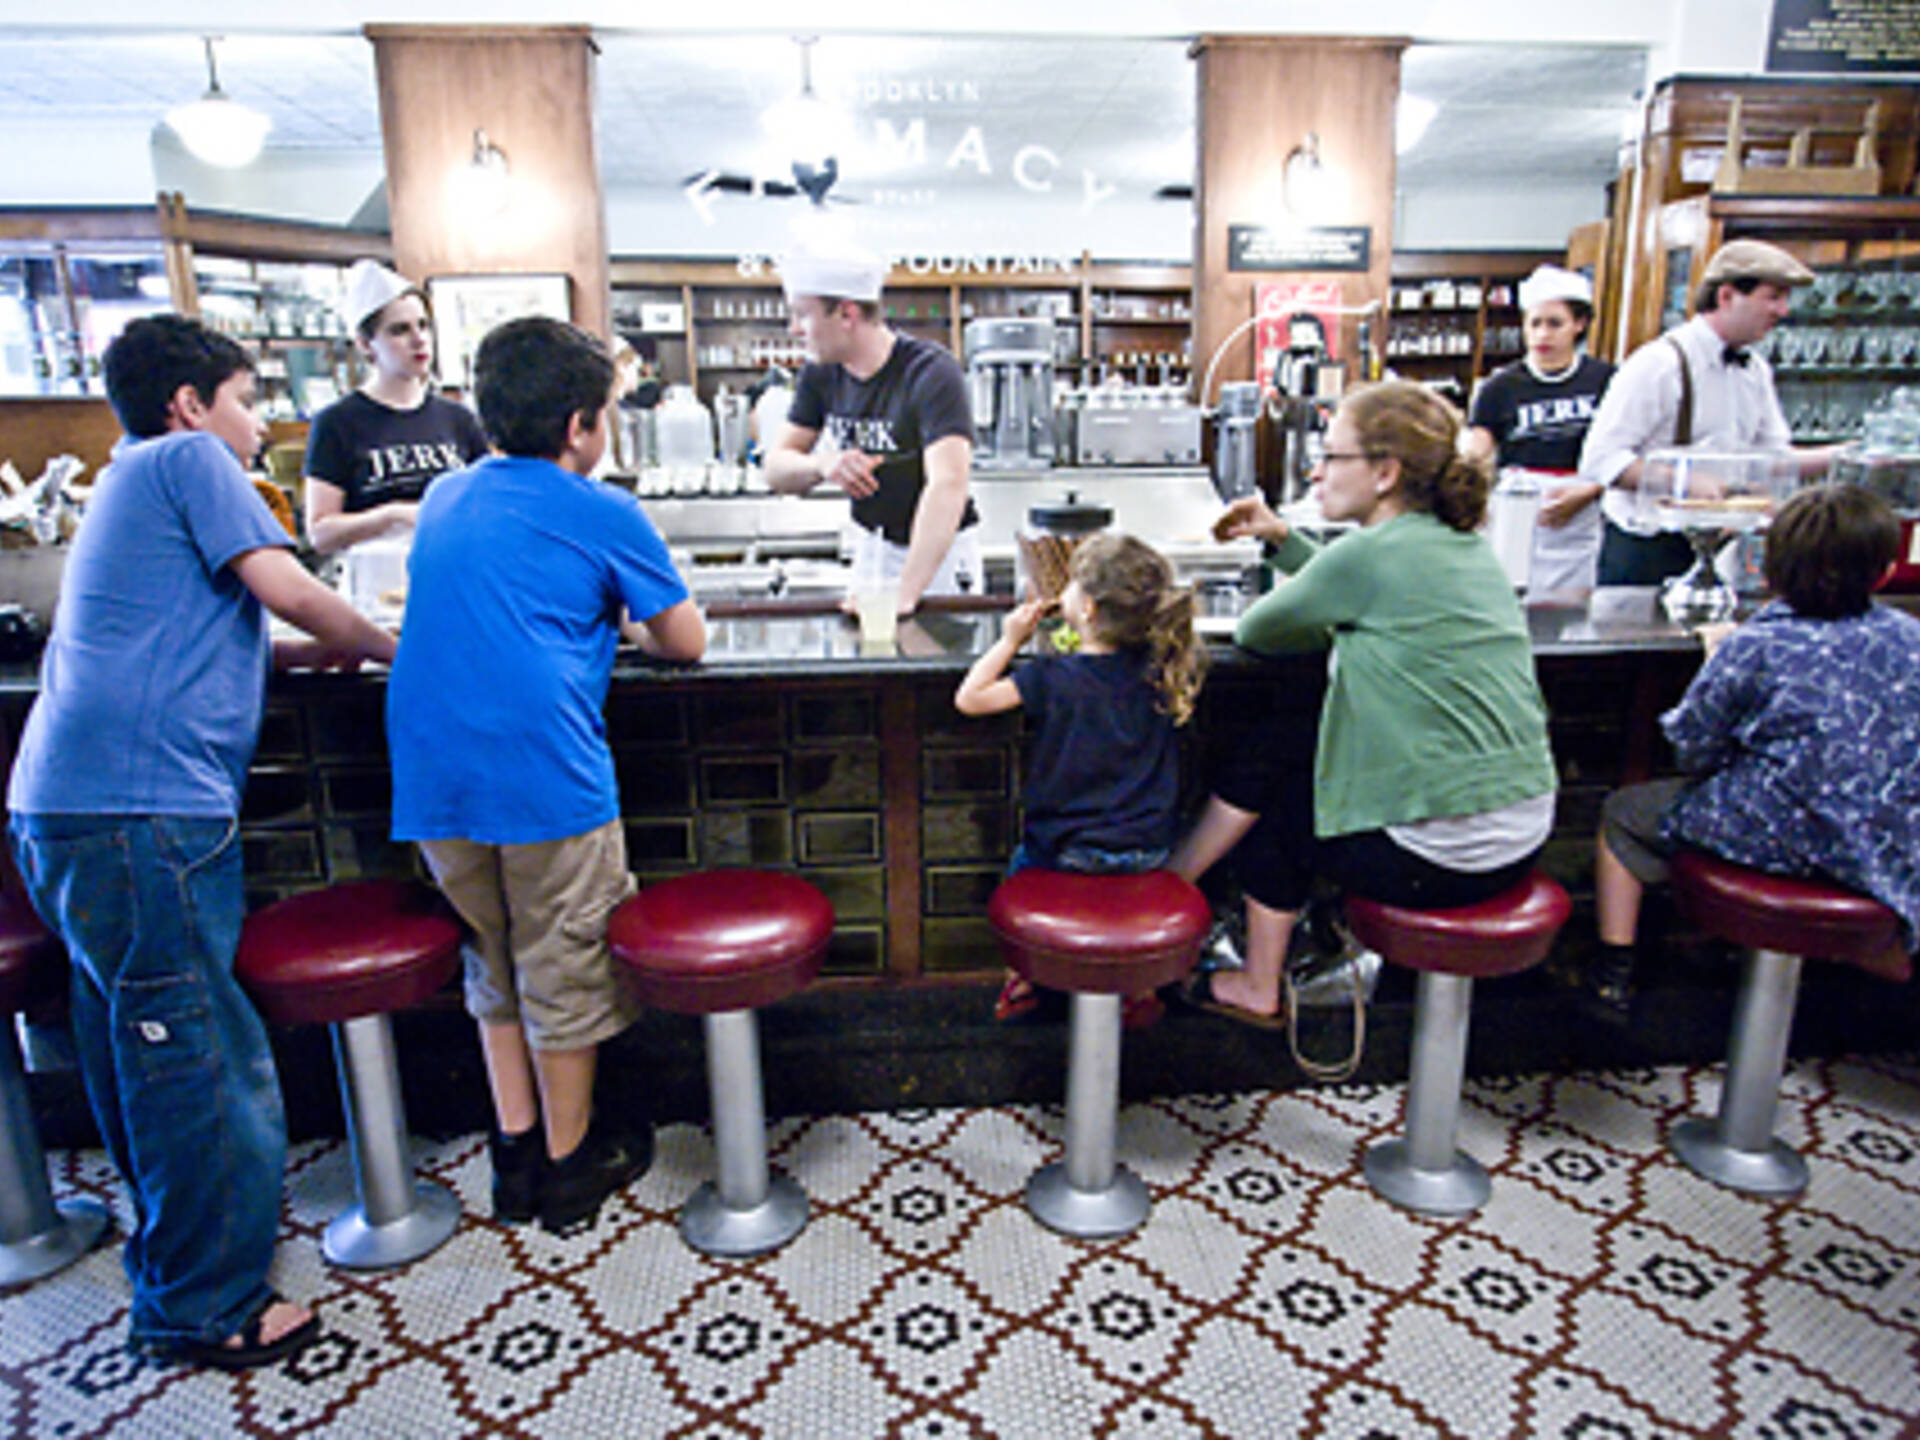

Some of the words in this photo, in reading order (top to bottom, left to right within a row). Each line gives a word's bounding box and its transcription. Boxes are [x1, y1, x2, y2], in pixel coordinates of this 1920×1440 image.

[860, 79, 982, 102] OOKLYN
[1513, 394, 1598, 435] JERK
[367, 442, 467, 483] JERK
